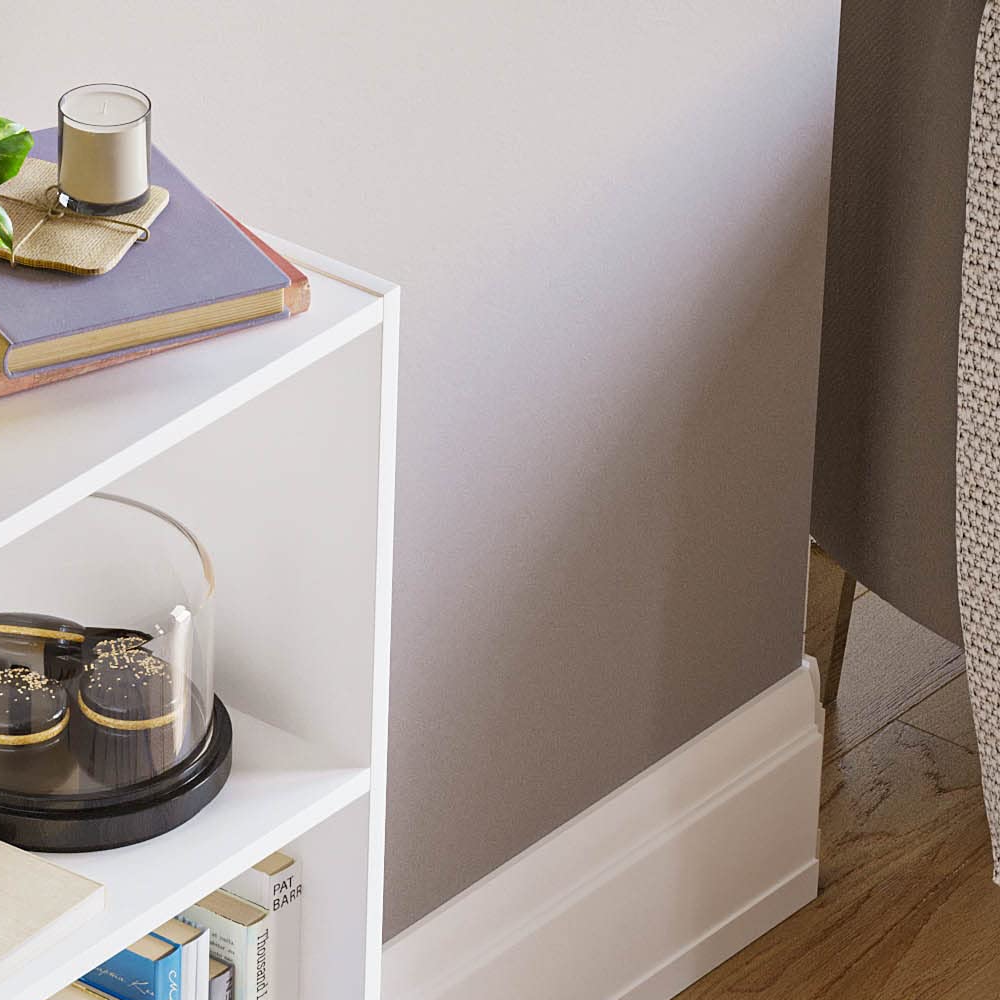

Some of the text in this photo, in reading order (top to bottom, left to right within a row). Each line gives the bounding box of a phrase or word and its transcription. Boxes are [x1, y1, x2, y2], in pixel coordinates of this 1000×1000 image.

[273, 875, 294, 896] PAT
[273, 884, 302, 911] BARR
[256, 928, 269, 992] Thousand
